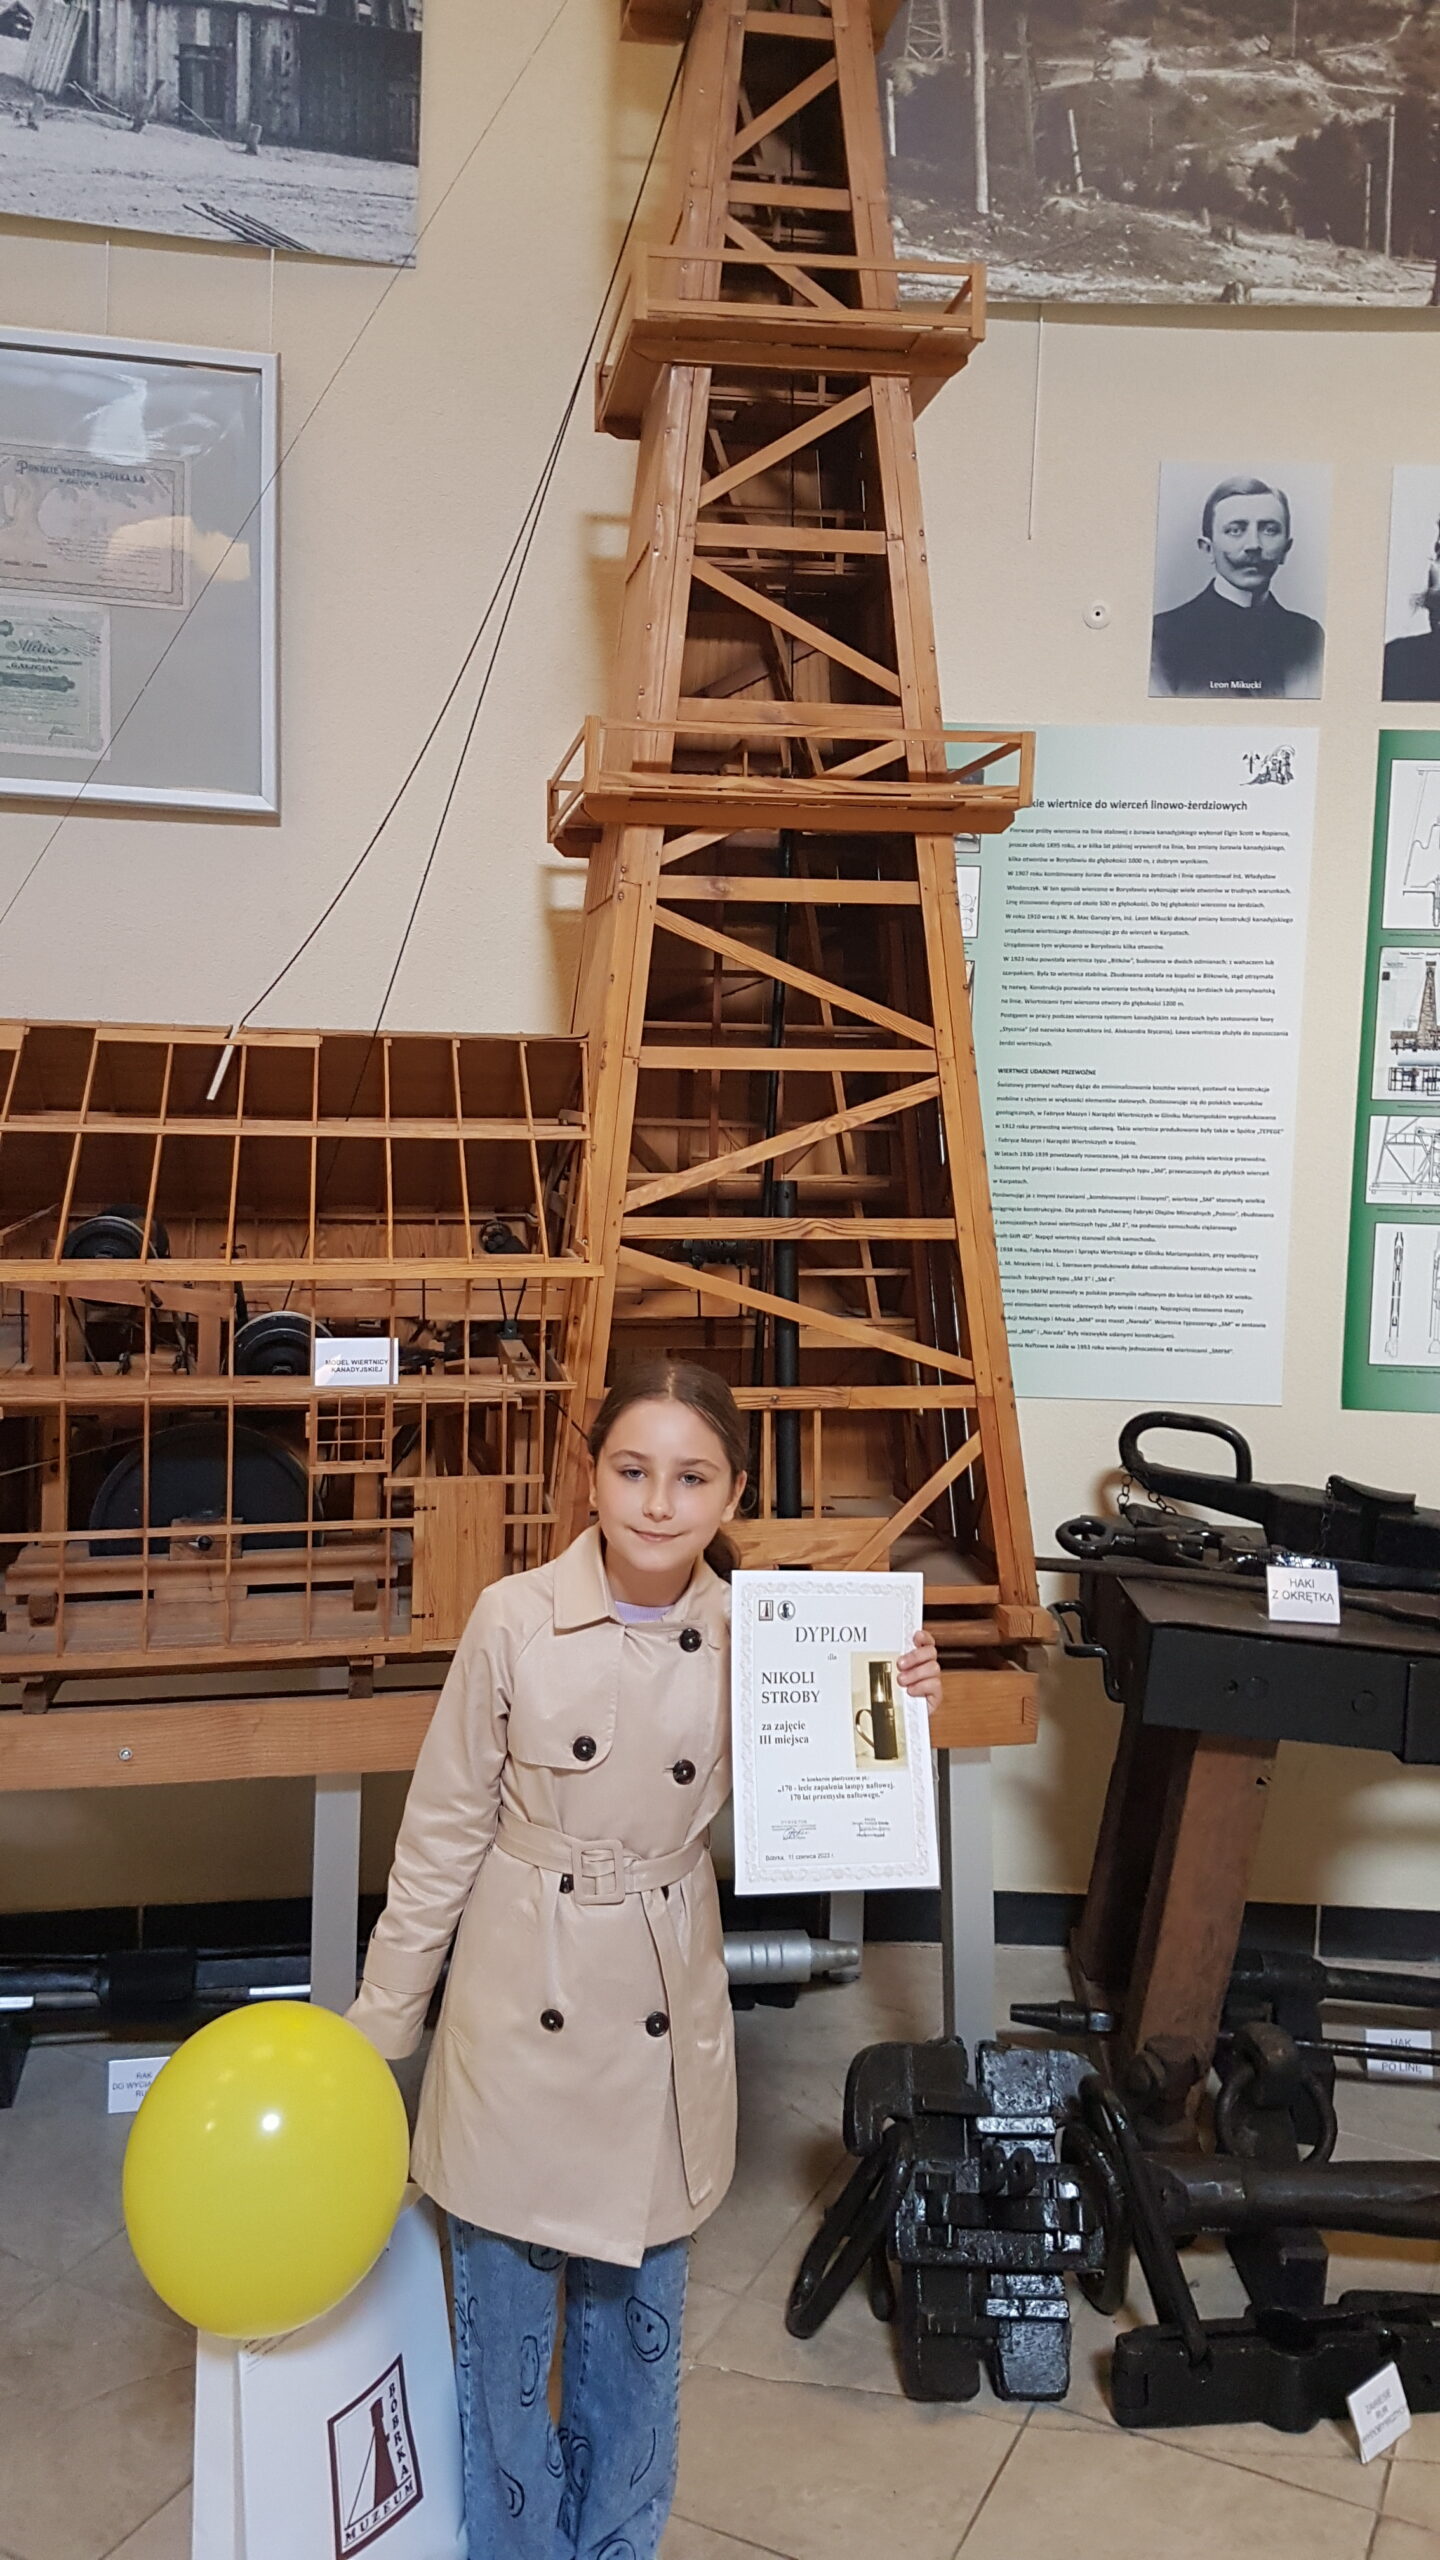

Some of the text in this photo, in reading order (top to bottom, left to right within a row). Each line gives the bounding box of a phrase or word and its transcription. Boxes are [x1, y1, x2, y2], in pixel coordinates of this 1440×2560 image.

[1209, 681, 1262, 689] Leon Mikucki
[1047, 799, 1093, 809] wiertnice
[1095, 799, 1107, 809] do
[1110, 799, 1148, 810] wierceń
[1150, 800, 1248, 813] linowo-żerdziowych
[1030, 1067, 1060, 1075] UDAROWE
[1289, 1578, 1315, 1589] HAKI
[1272, 1590, 1334, 1604] Z OKRĘTKĄ
[795, 1626, 867, 1643] DYPLOM
[827, 1653, 837, 1661] dla
[761, 1671, 815, 1684] NIKOLI
[761, 1690, 820, 1704] STROBY
[761, 1720, 806, 1733] za zajęcie
[759, 1734, 809, 1746] III miejsca
[798, 1784, 812, 1792] lecie
[814, 1784, 843, 1793] zapalenia
[844, 1783, 864, 1791] lampy
[802, 1793, 811, 1801] lat
[812, 1793, 845, 1802] przemysłu
[112, 2083, 124, 2091] DO
[344, 2479, 414, 2543] MUZEUM
